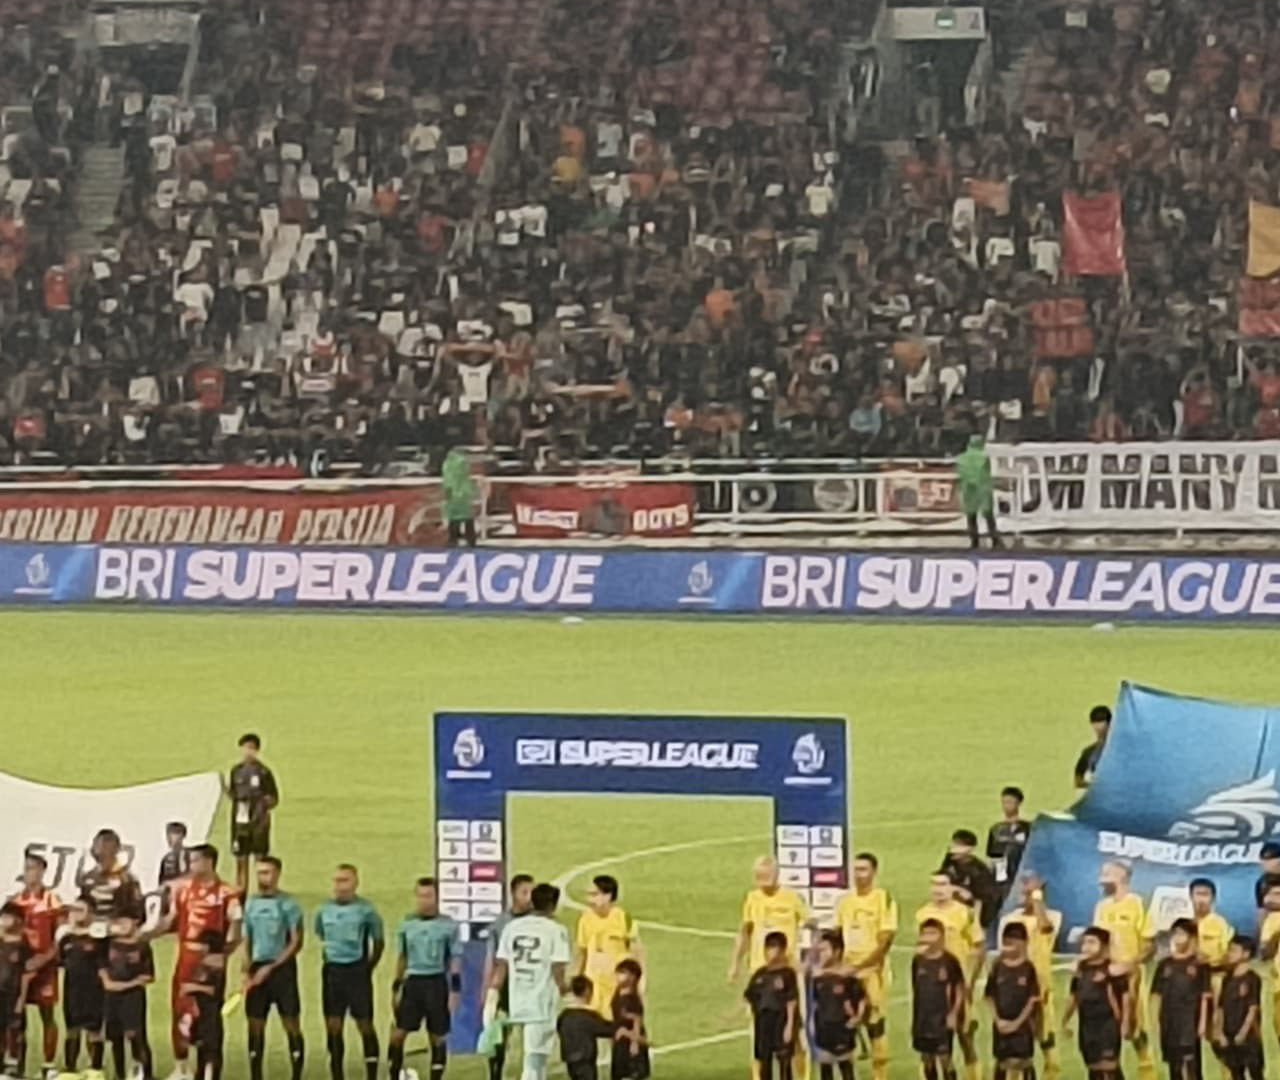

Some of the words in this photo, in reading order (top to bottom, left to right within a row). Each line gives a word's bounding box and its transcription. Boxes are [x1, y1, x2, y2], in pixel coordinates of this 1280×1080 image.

[1099, 453, 1246, 512] MANY
[95, 547, 174, 600] BRI
[761, 555, 845, 608] BRI
[14, 841, 136, 891] ST
